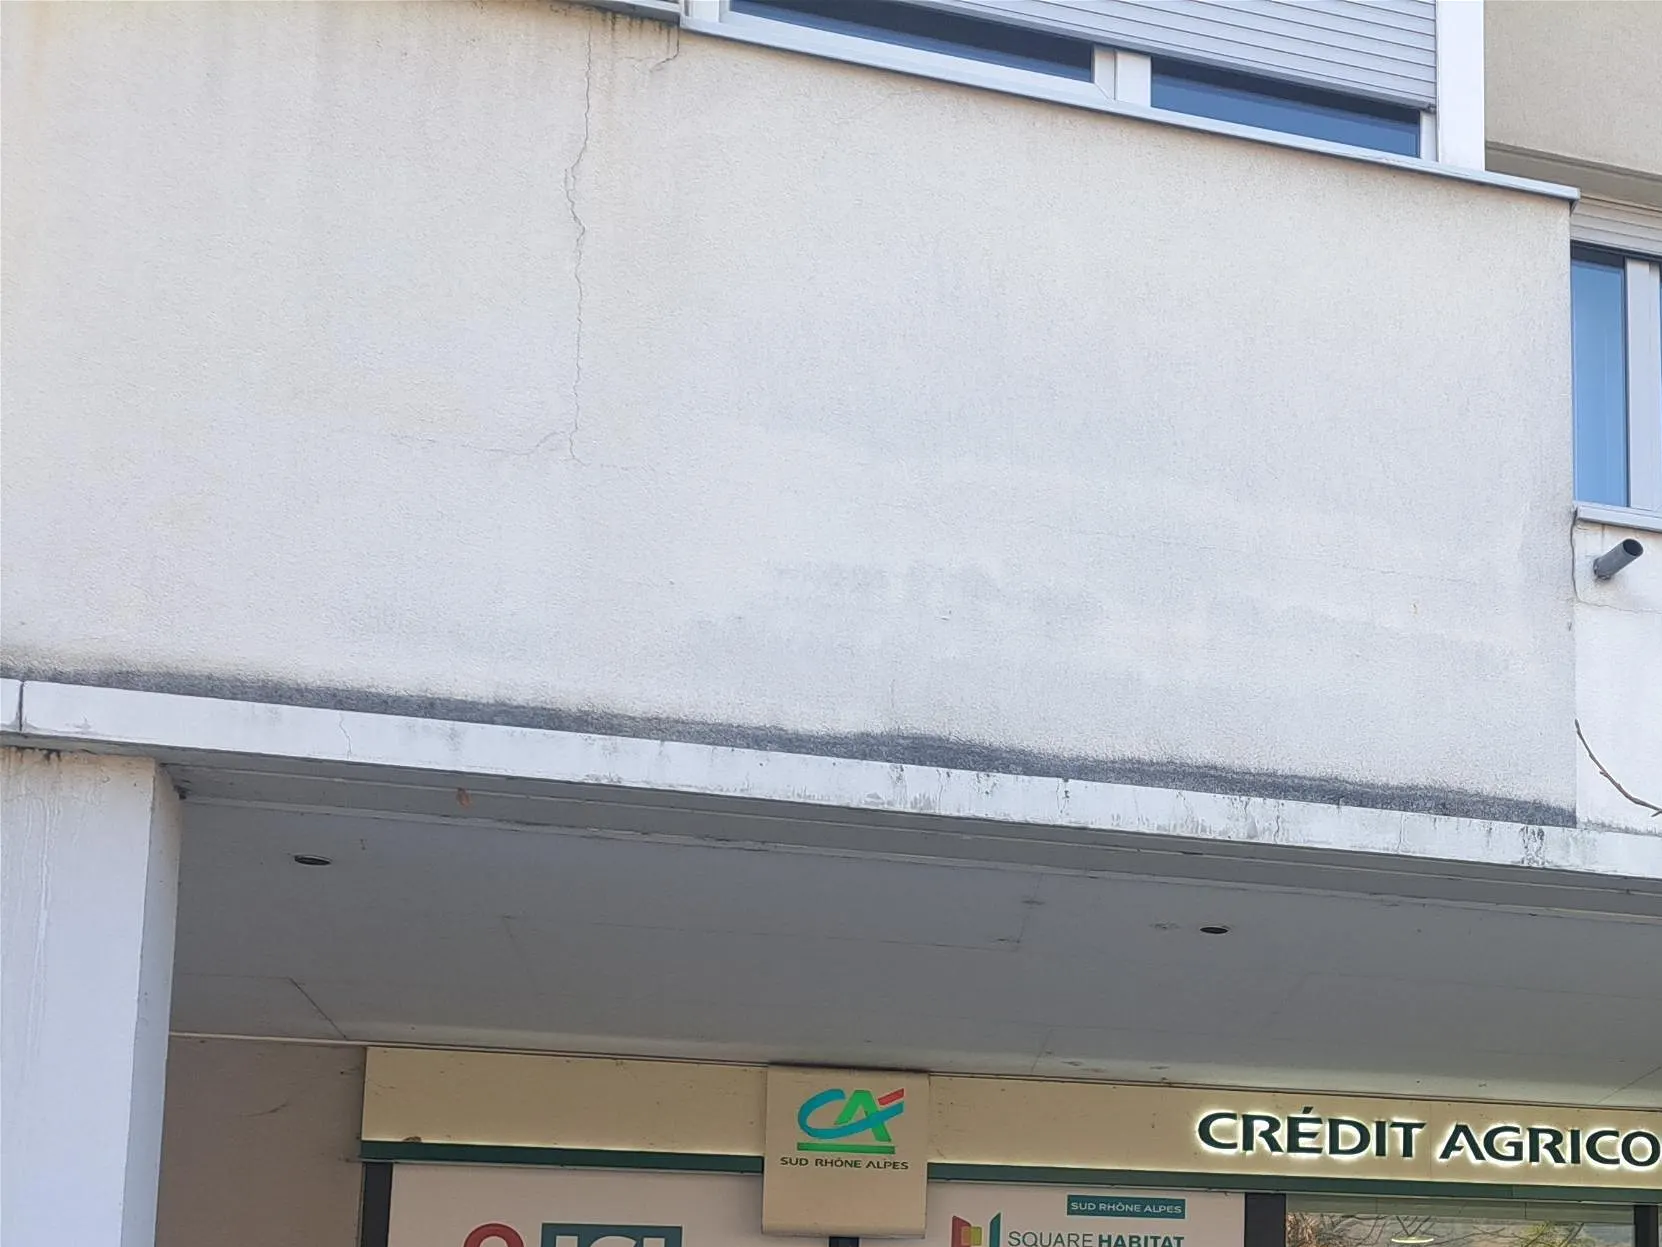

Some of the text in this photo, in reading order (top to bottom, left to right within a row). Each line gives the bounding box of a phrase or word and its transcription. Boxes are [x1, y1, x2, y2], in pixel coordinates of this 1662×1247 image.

[1197, 1105, 1427, 1159] CRÉDIT
[780, 1156, 909, 1170] SUD RHÔNE ALPES
[1071, 1202, 1182, 1213] SUD RHÔNE ALPES
